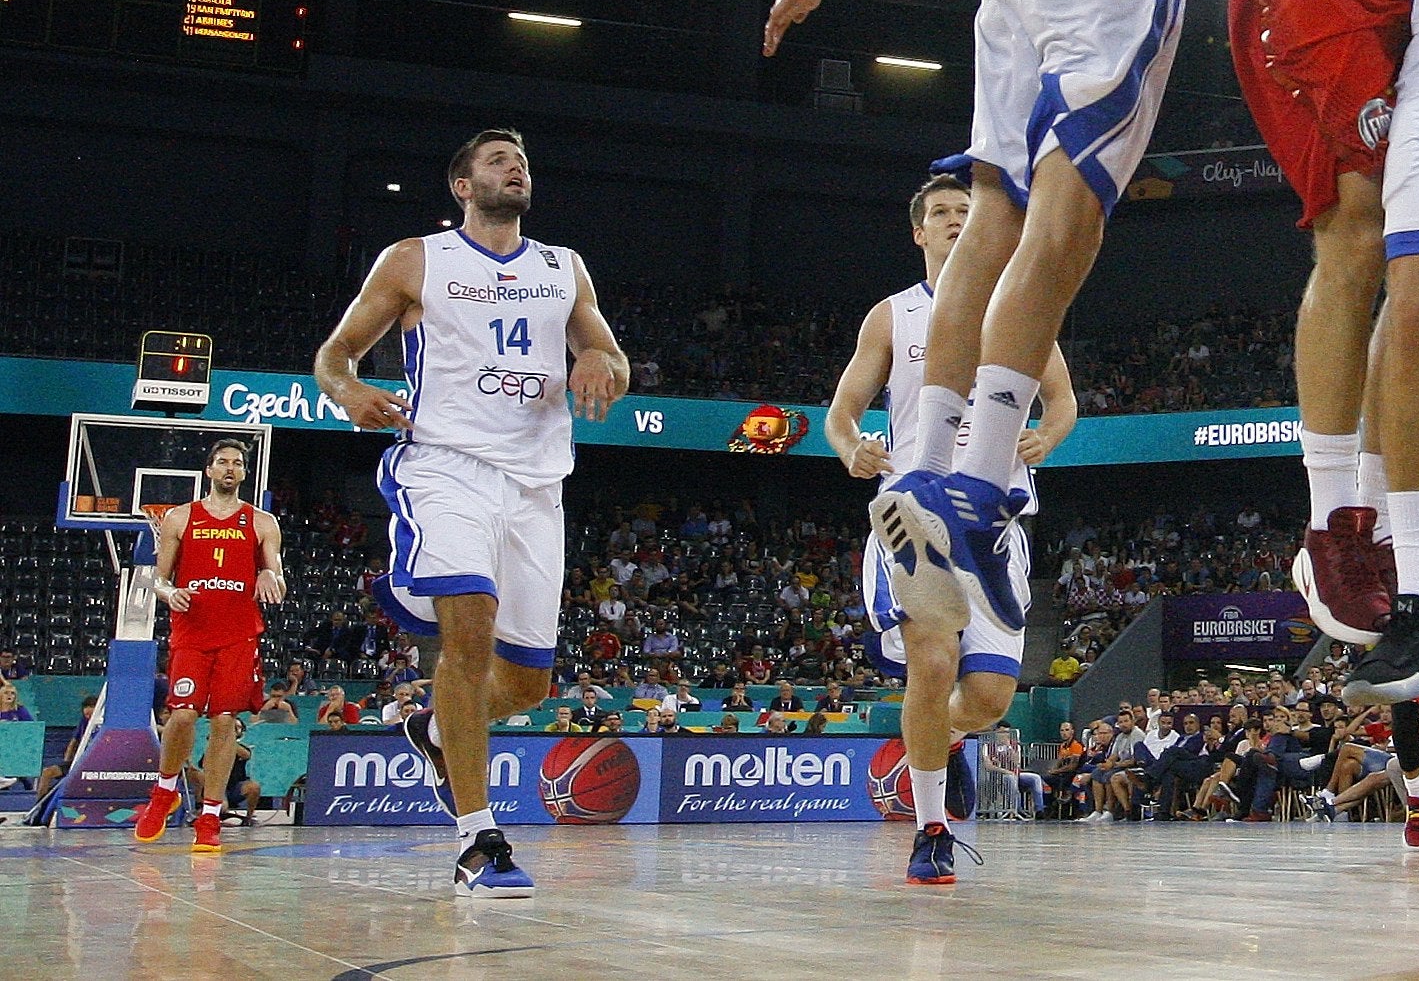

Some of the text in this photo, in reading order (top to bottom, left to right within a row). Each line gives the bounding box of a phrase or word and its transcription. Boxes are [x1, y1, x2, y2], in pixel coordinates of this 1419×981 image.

[489, 317, 532, 356] 14
[161, 387, 203, 397] TISSOT
[222, 382, 314, 425] Czech
[634, 410, 664, 434] VS
[192, 527, 246, 541] ESPAÑA
[213, 547, 225, 568] 4
[188, 576, 245, 592] endesa
[1193, 619, 1277, 636] EUROBASKET
[684, 746, 851, 787] molten
[325, 795, 363, 816] For
[367, 793, 402, 813] the
[405, 799, 446, 814] rea
[677, 792, 851, 818] For the real game
